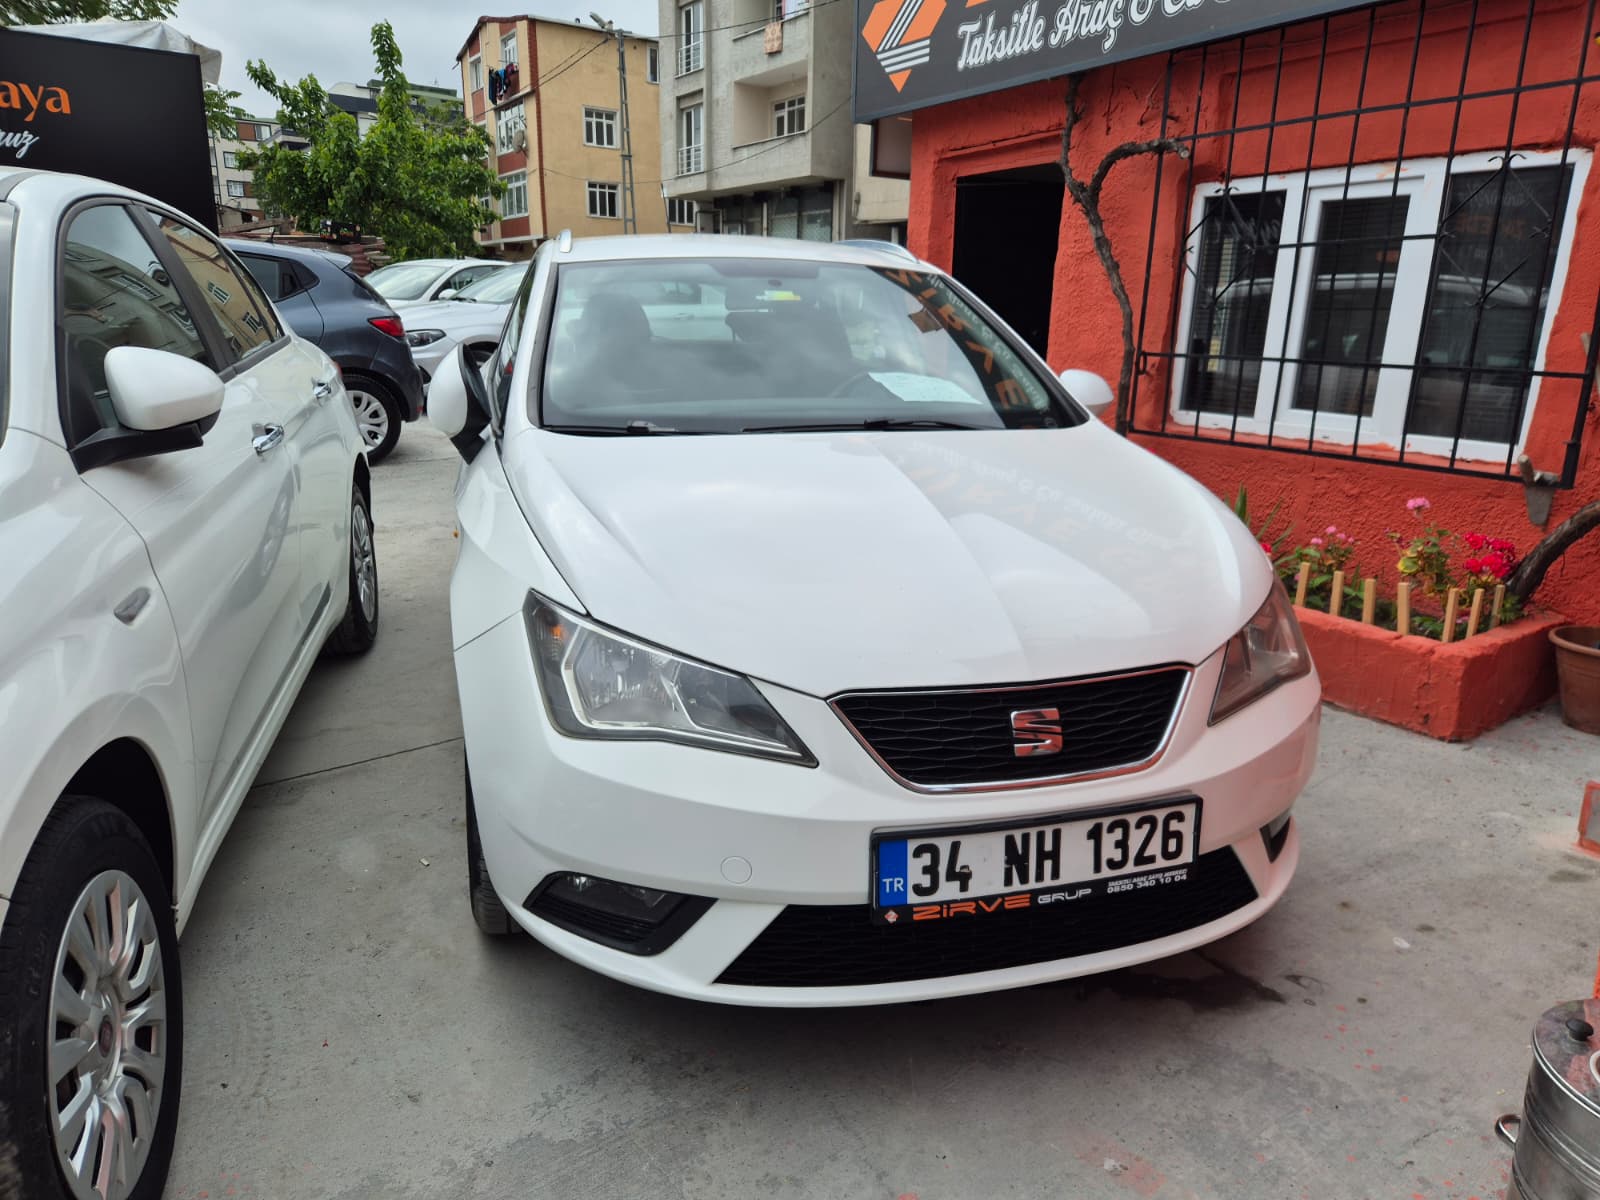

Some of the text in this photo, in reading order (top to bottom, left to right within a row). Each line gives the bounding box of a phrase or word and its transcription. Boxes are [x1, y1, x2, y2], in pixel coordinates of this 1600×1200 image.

[958, 0, 1043, 71] Taksitle
[1049, 0, 1125, 53] Araç
[911, 810, 1186, 897] 34 NH 1326
[882, 877, 905, 894] TR
[1106, 873, 1187, 894] 0850 340 10 04
[1037, 888, 1093, 905] GRUP
